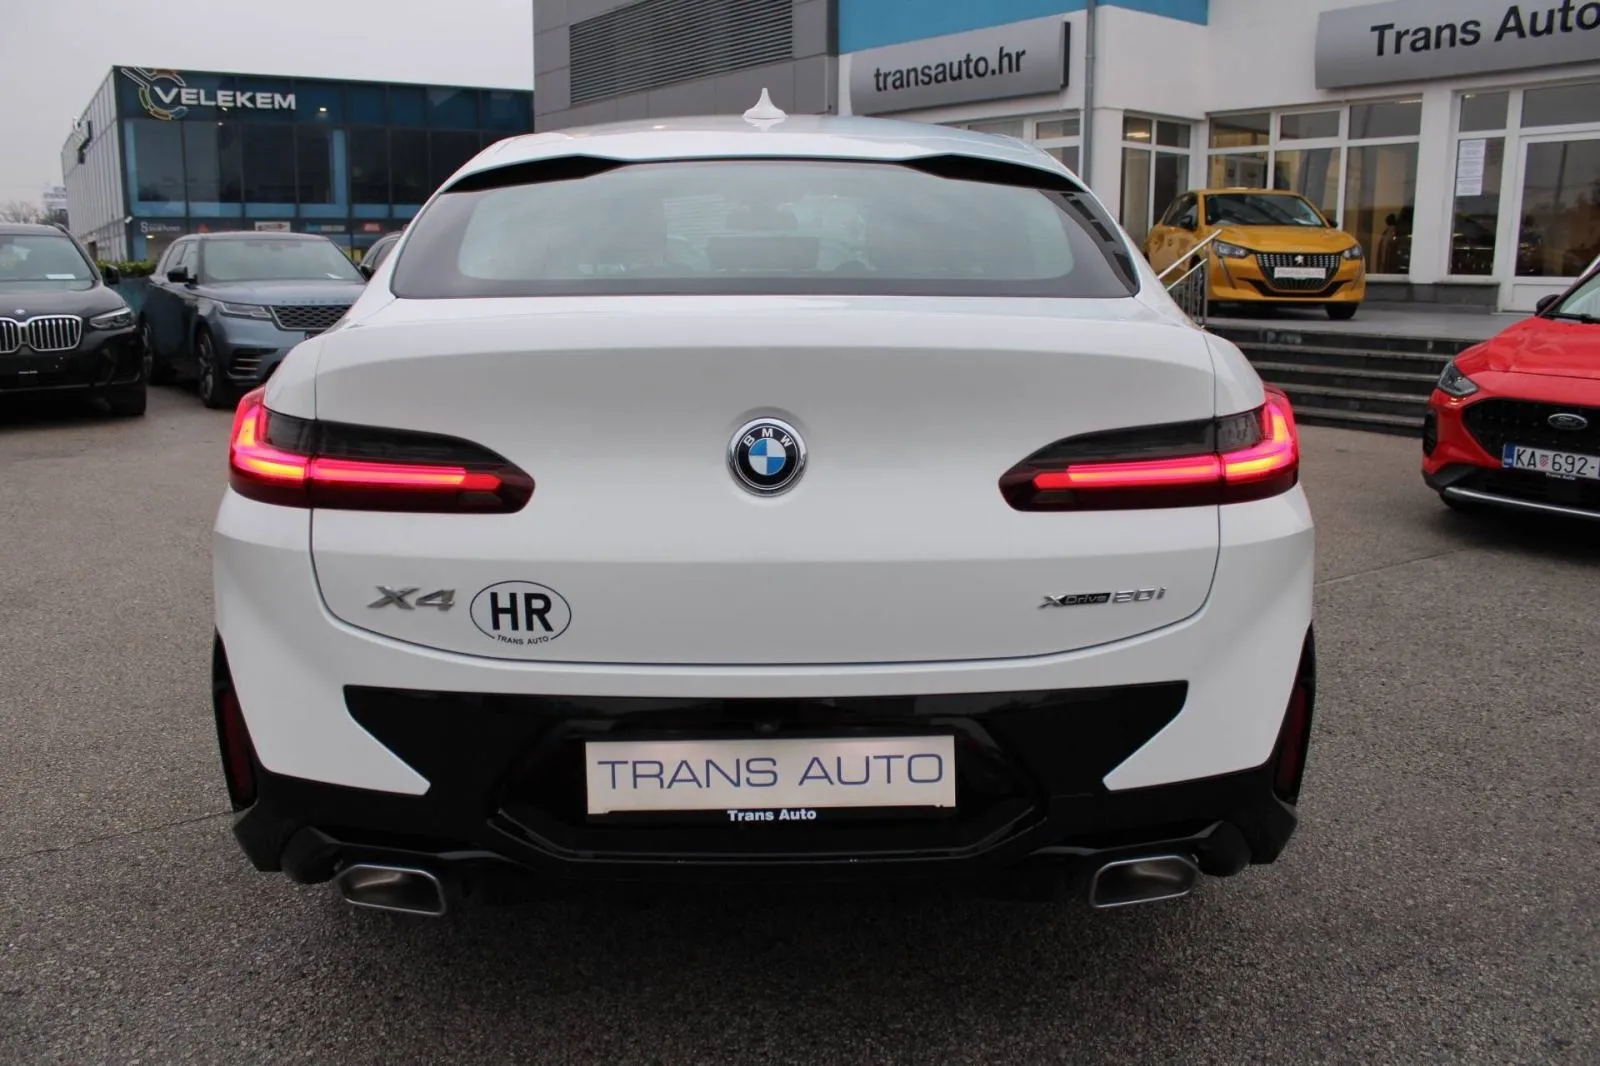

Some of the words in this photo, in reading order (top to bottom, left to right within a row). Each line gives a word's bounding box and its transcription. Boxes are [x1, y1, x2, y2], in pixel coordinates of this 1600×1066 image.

[1370, 19, 1481, 57] Trans
[1494, 0, 1600, 42] Auto
[874, 46, 1026, 92] transauto.hr
[153, 86, 296, 110] VELEKEM
[743, 427, 793, 447] BMW
[1516, 448, 1537, 468] KA
[366, 585, 456, 612] X4
[490, 591, 554, 632] HR
[497, 634, 524, 646] TRANS
[527, 635, 549, 645] AUTO
[597, 757, 778, 789] TRANS
[798, 753, 944, 787] AUTO
[727, 810, 774, 822] Trans
[779, 808, 817, 821] Auto
